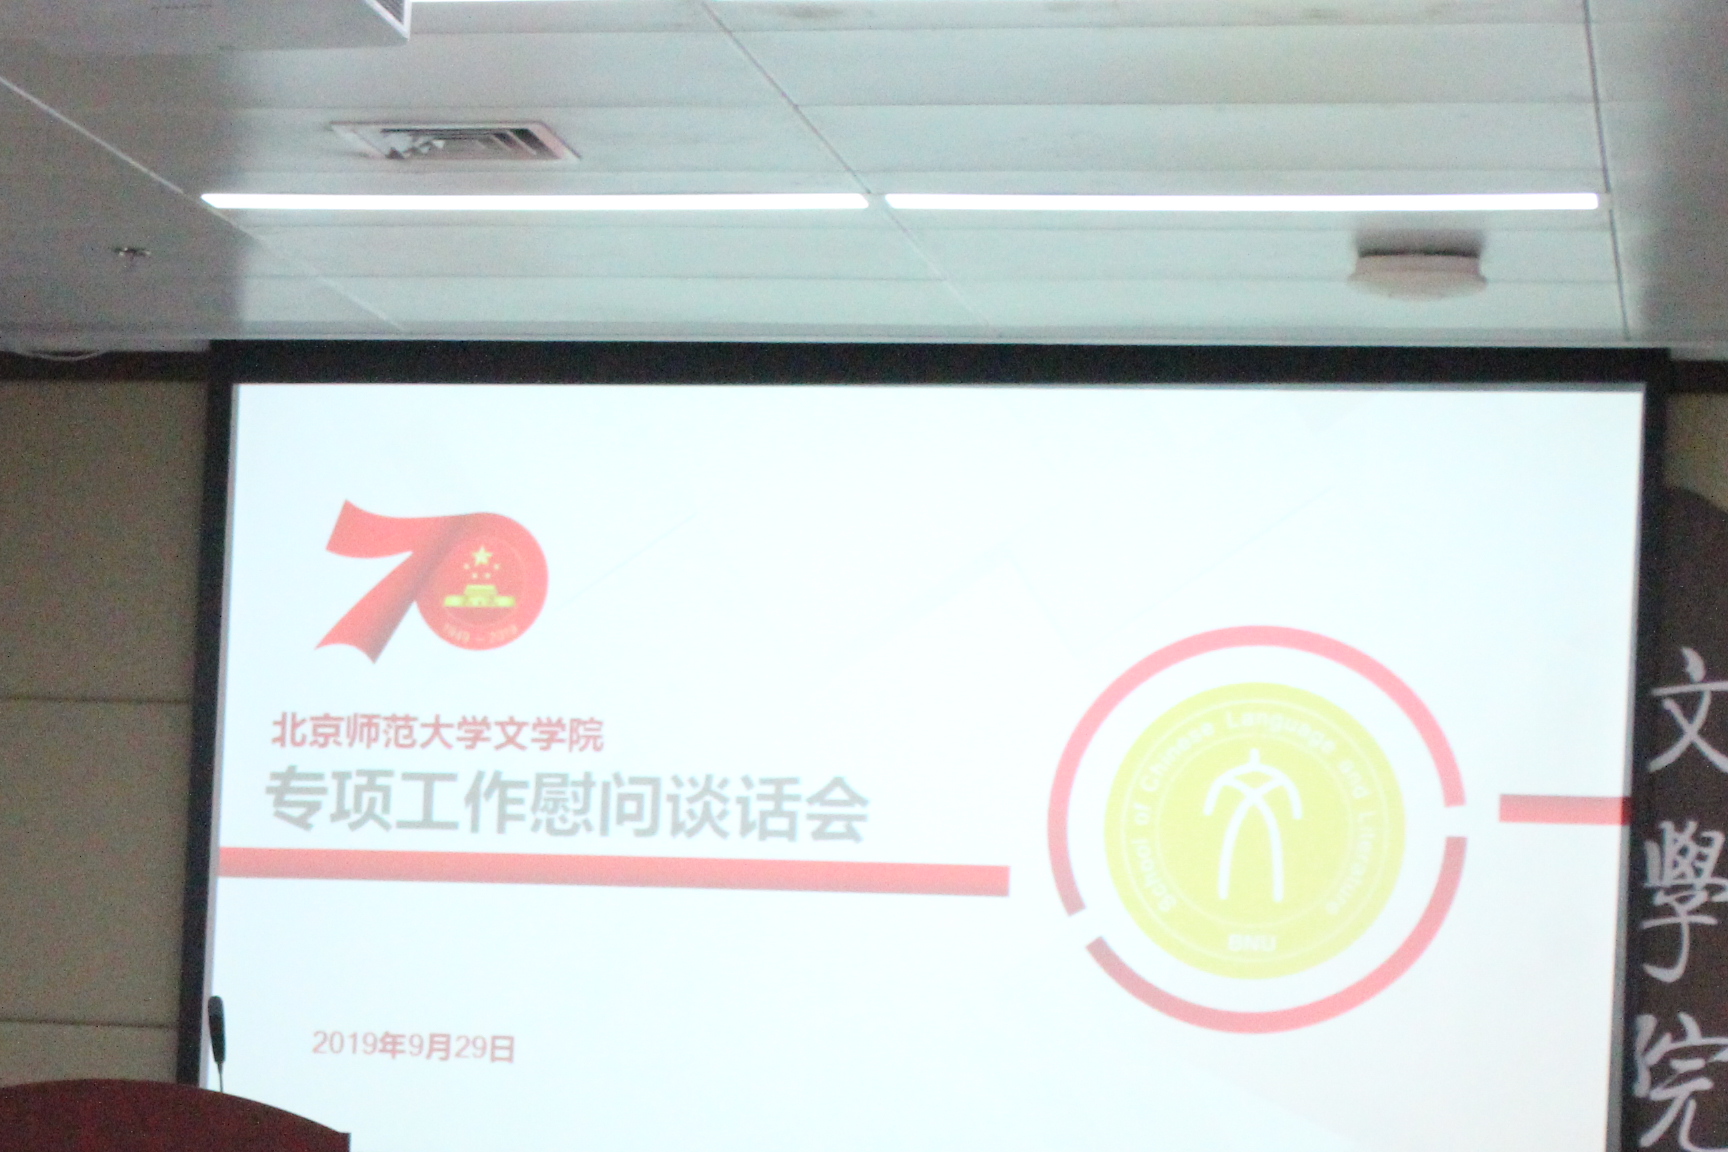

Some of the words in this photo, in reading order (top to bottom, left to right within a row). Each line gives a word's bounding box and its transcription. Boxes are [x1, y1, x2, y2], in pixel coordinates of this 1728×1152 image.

[272, 712, 605, 752] 北京师范大学文学院
[1225, 710, 1337, 755] Language
[1139, 721, 1215, 793] Chinese
[1337, 758, 1372, 800] and
[264, 764, 871, 844] 专项工作慰问谈话会
[1132, 802, 1151, 825] of
[1131, 838, 1177, 912] School
[311, 1030, 517, 1064] 2019年9月29日
